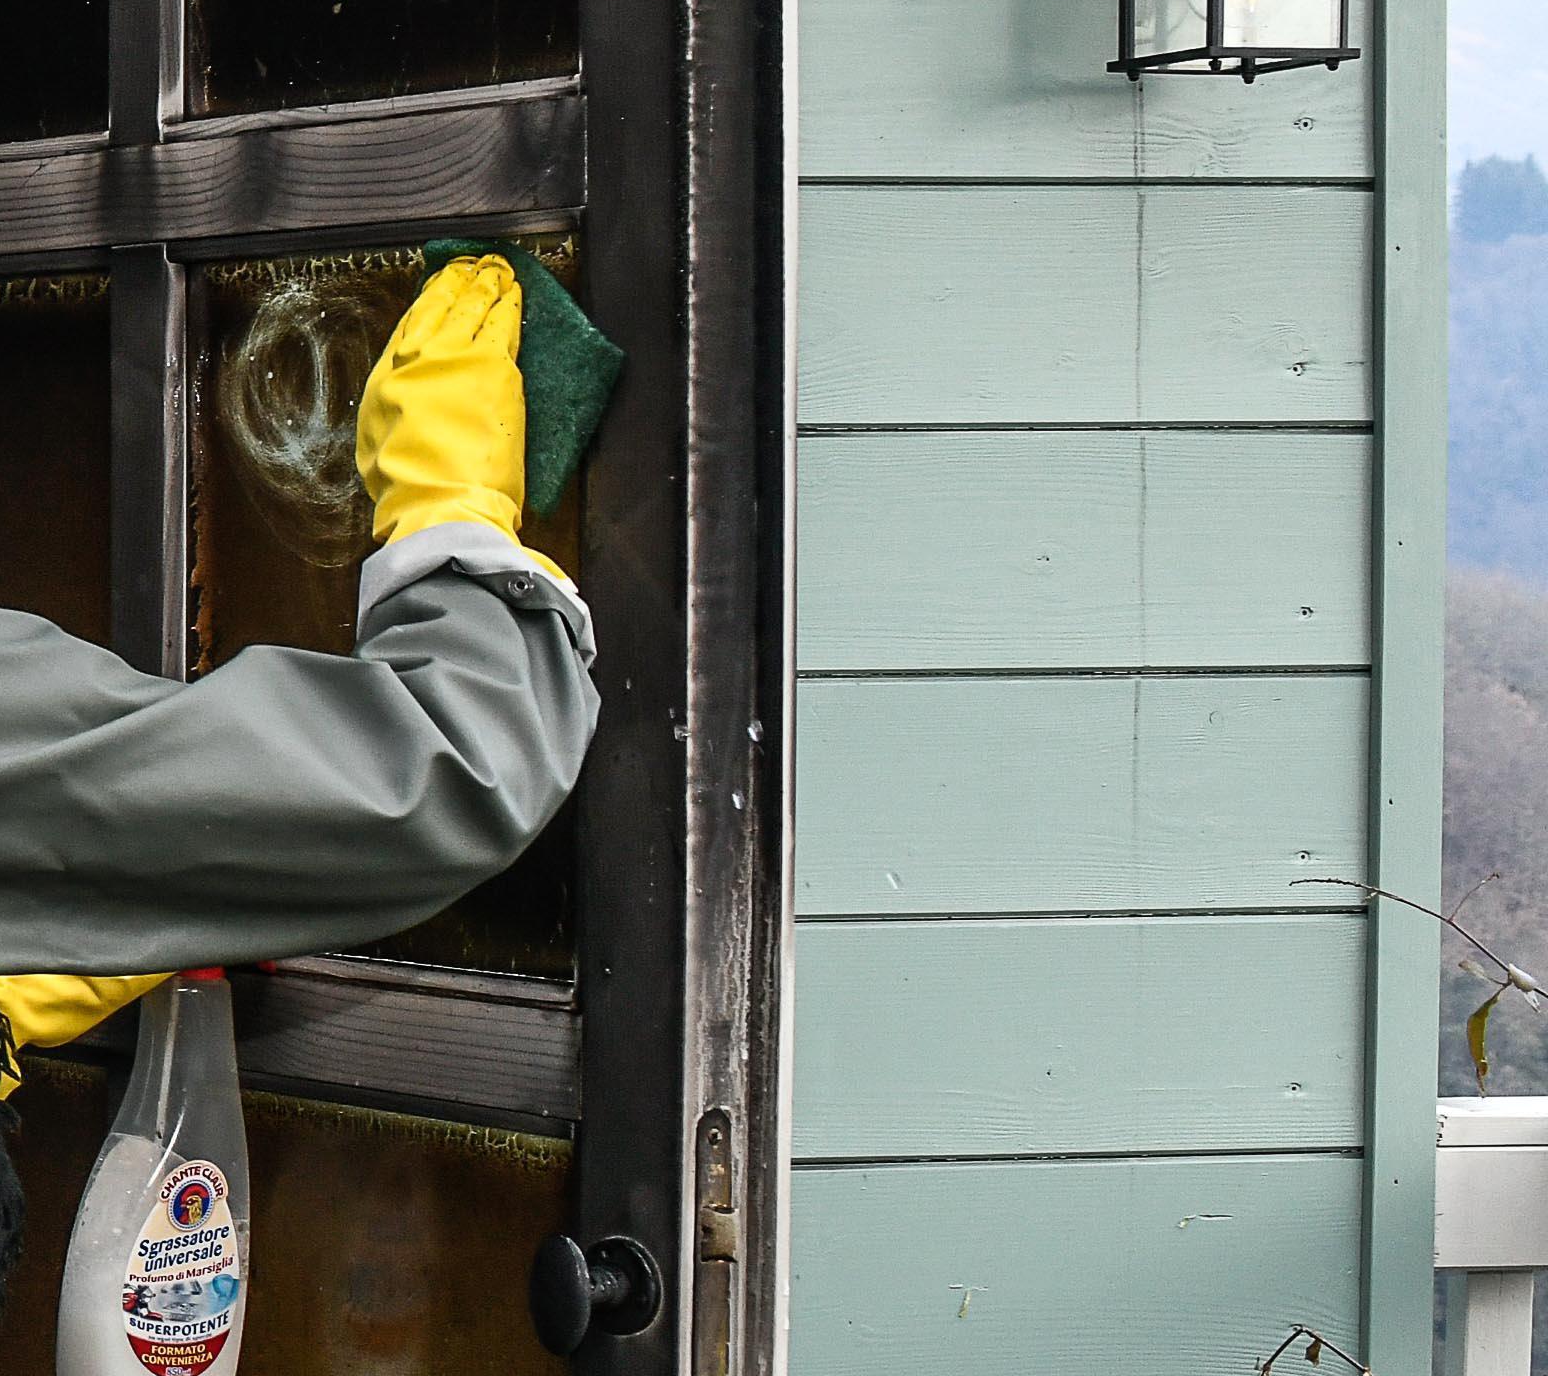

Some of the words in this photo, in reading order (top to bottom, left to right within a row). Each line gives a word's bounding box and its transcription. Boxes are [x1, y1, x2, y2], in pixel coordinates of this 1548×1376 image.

[161, 1166, 201, 1199] CHANTE
[202, 1168, 224, 1197] CLAIR
[138, 1226, 230, 1259] Sgrassatore
[129, 1274, 174, 1283] Profumo
[175, 1272, 185, 1281] di
[186, 1256, 234, 1279] Marsiglia
[145, 1242, 223, 1272] universale
[129, 1310, 230, 1336] SUPERPOTENTE
[141, 1352, 213, 1366] CONVENIENZA
[151, 1344, 206, 1355] FORMATO
